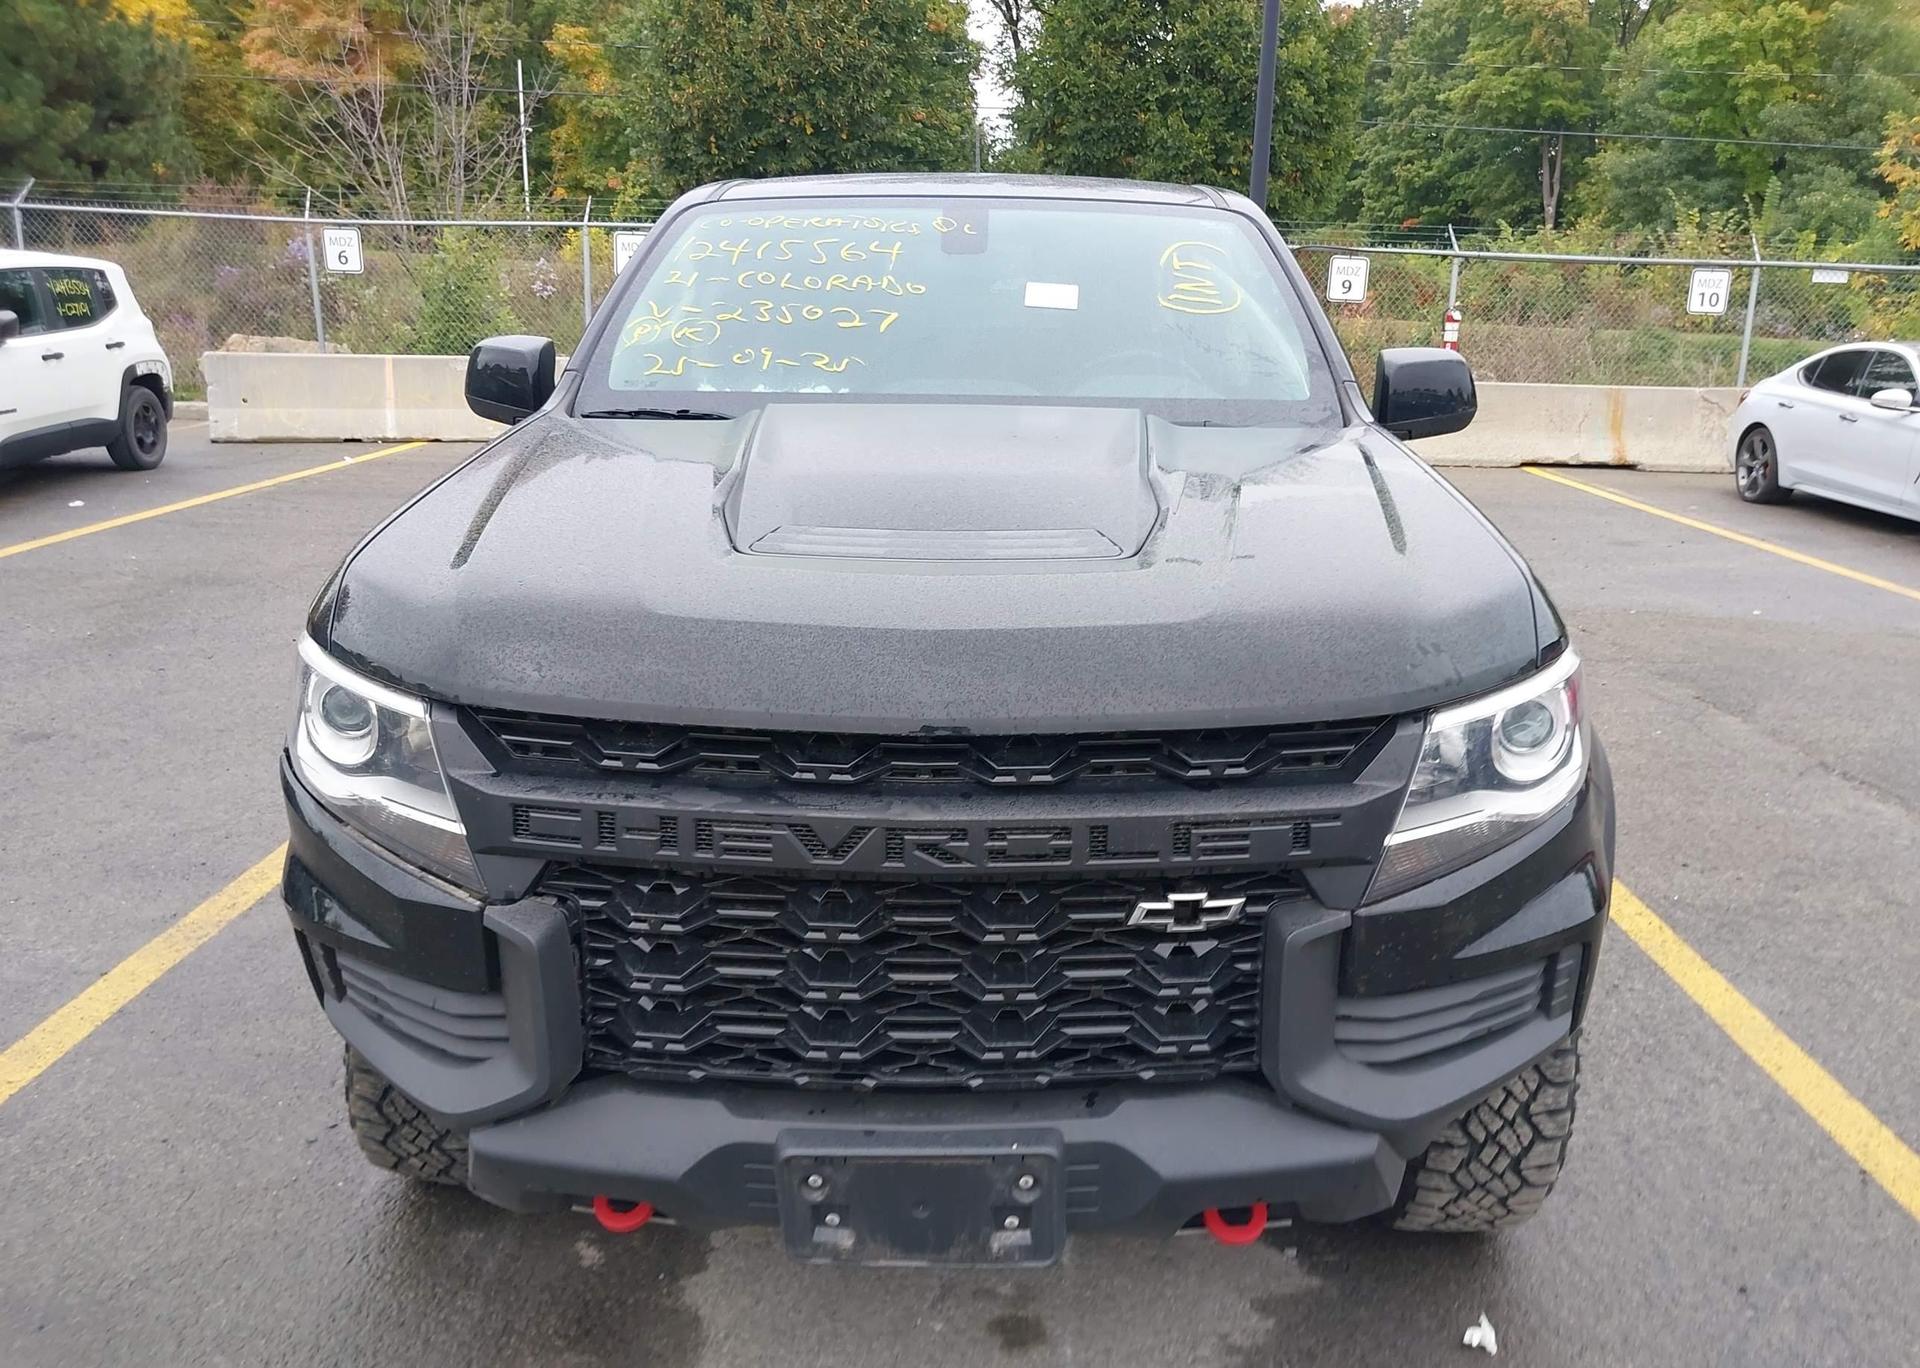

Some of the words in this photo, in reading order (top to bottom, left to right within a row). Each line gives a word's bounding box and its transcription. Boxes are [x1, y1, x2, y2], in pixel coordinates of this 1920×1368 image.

[329, 236, 353, 248] MDZ
[338, 250, 348, 265] 6
[673, 236, 904, 269] 12415564
[1335, 265, 1362, 277] MDZ
[1341, 279, 1352, 295] 9
[1697, 278, 1724, 290] MDZ
[1698, 292, 1720, 308] 10
[511, 803, 1342, 868] CHEVROLET
